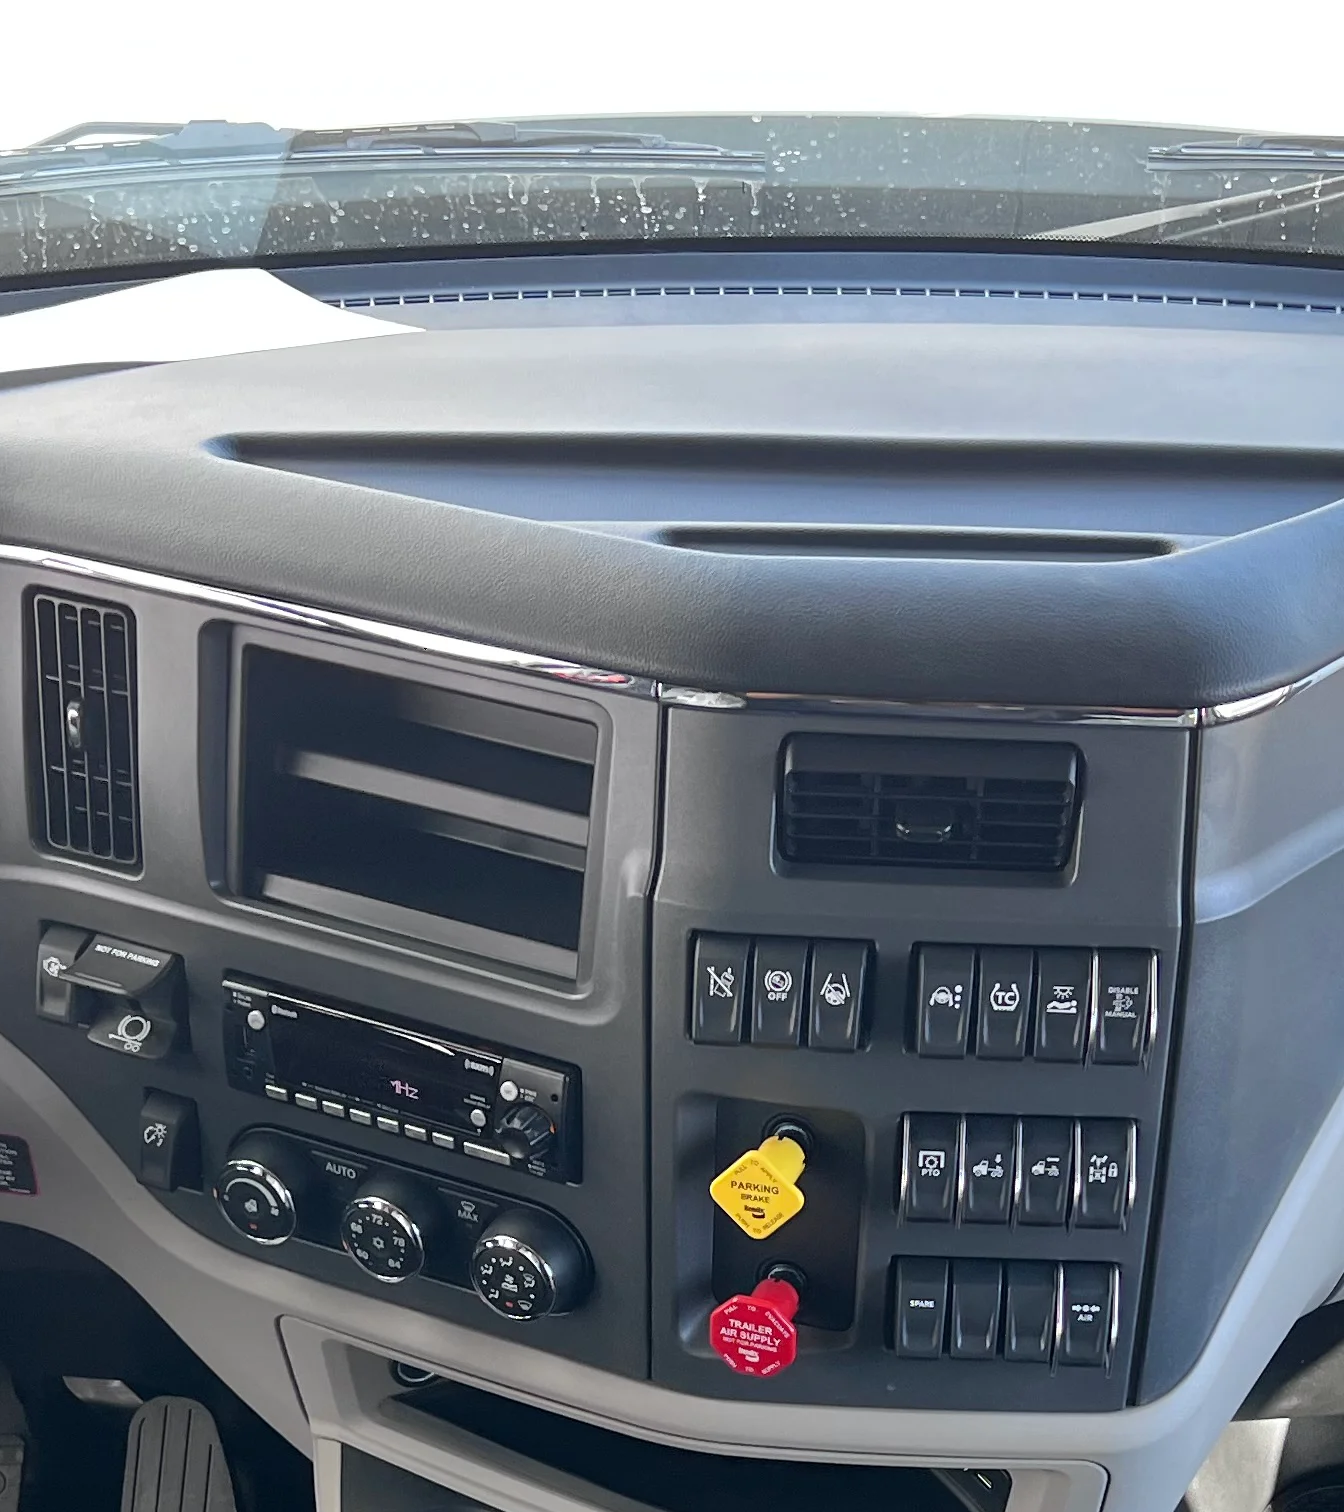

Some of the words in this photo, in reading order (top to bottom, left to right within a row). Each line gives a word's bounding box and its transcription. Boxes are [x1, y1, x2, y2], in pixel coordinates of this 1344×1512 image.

[94, 944, 112, 954] NOT
[110, 948, 127, 958] FOR
[126, 952, 160, 967] PARKING
[1108, 986, 1139, 995] DISABLE
[767, 992, 788, 1001] OFF
[996, 992, 1015, 1005] TC
[1104, 1010, 1137, 1018] MANUAL
[325, 1161, 357, 1179] AUTO
[921, 1168, 941, 1177] PTO
[730, 1180, 779, 1195] PARKING
[741, 1193, 771, 1203] BRAKE
[371, 1214, 383, 1225] 72
[457, 1209, 479, 1222] MAX
[909, 1300, 935, 1308] SPARE
[1077, 1314, 1093, 1322] AIR
[728, 1318, 773, 1336] TRAILER
[719, 1326, 737, 1337] AIR
[739, 1331, 781, 1347] SUPPLY
